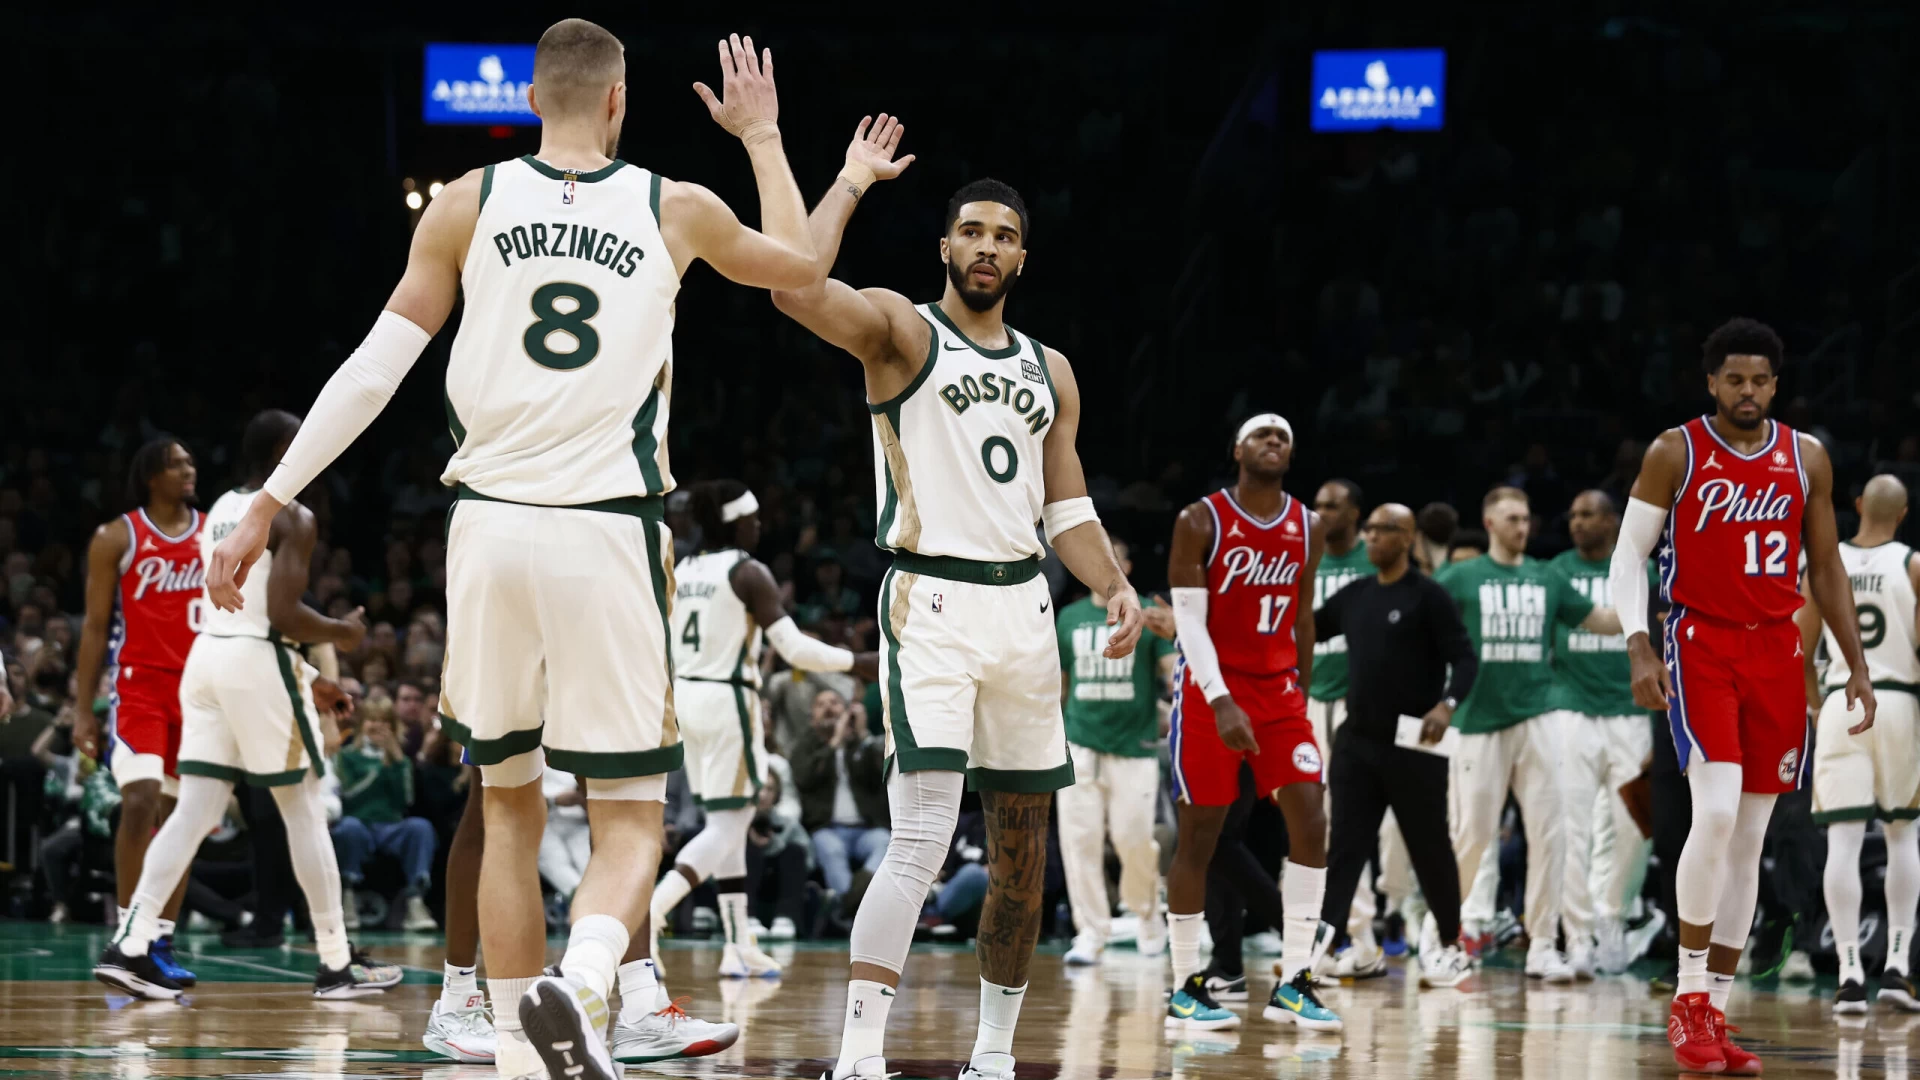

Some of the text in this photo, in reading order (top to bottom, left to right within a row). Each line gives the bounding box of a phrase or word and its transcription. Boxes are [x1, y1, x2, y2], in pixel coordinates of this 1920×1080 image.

[494, 223, 644, 278] PORZINGIS
[522, 281, 600, 371] 8
[1021, 360, 1041, 375] VISTA
[938, 373, 1049, 435] BOSTON
[981, 435, 1018, 484] 0
[1694, 478, 1793, 532] Phila
[1218, 546, 1300, 594] Phila
[1744, 530, 1788, 576] 12
[682, 609, 700, 653] 4
[1256, 594, 1292, 635] 17
[1855, 603, 1887, 650] 9
